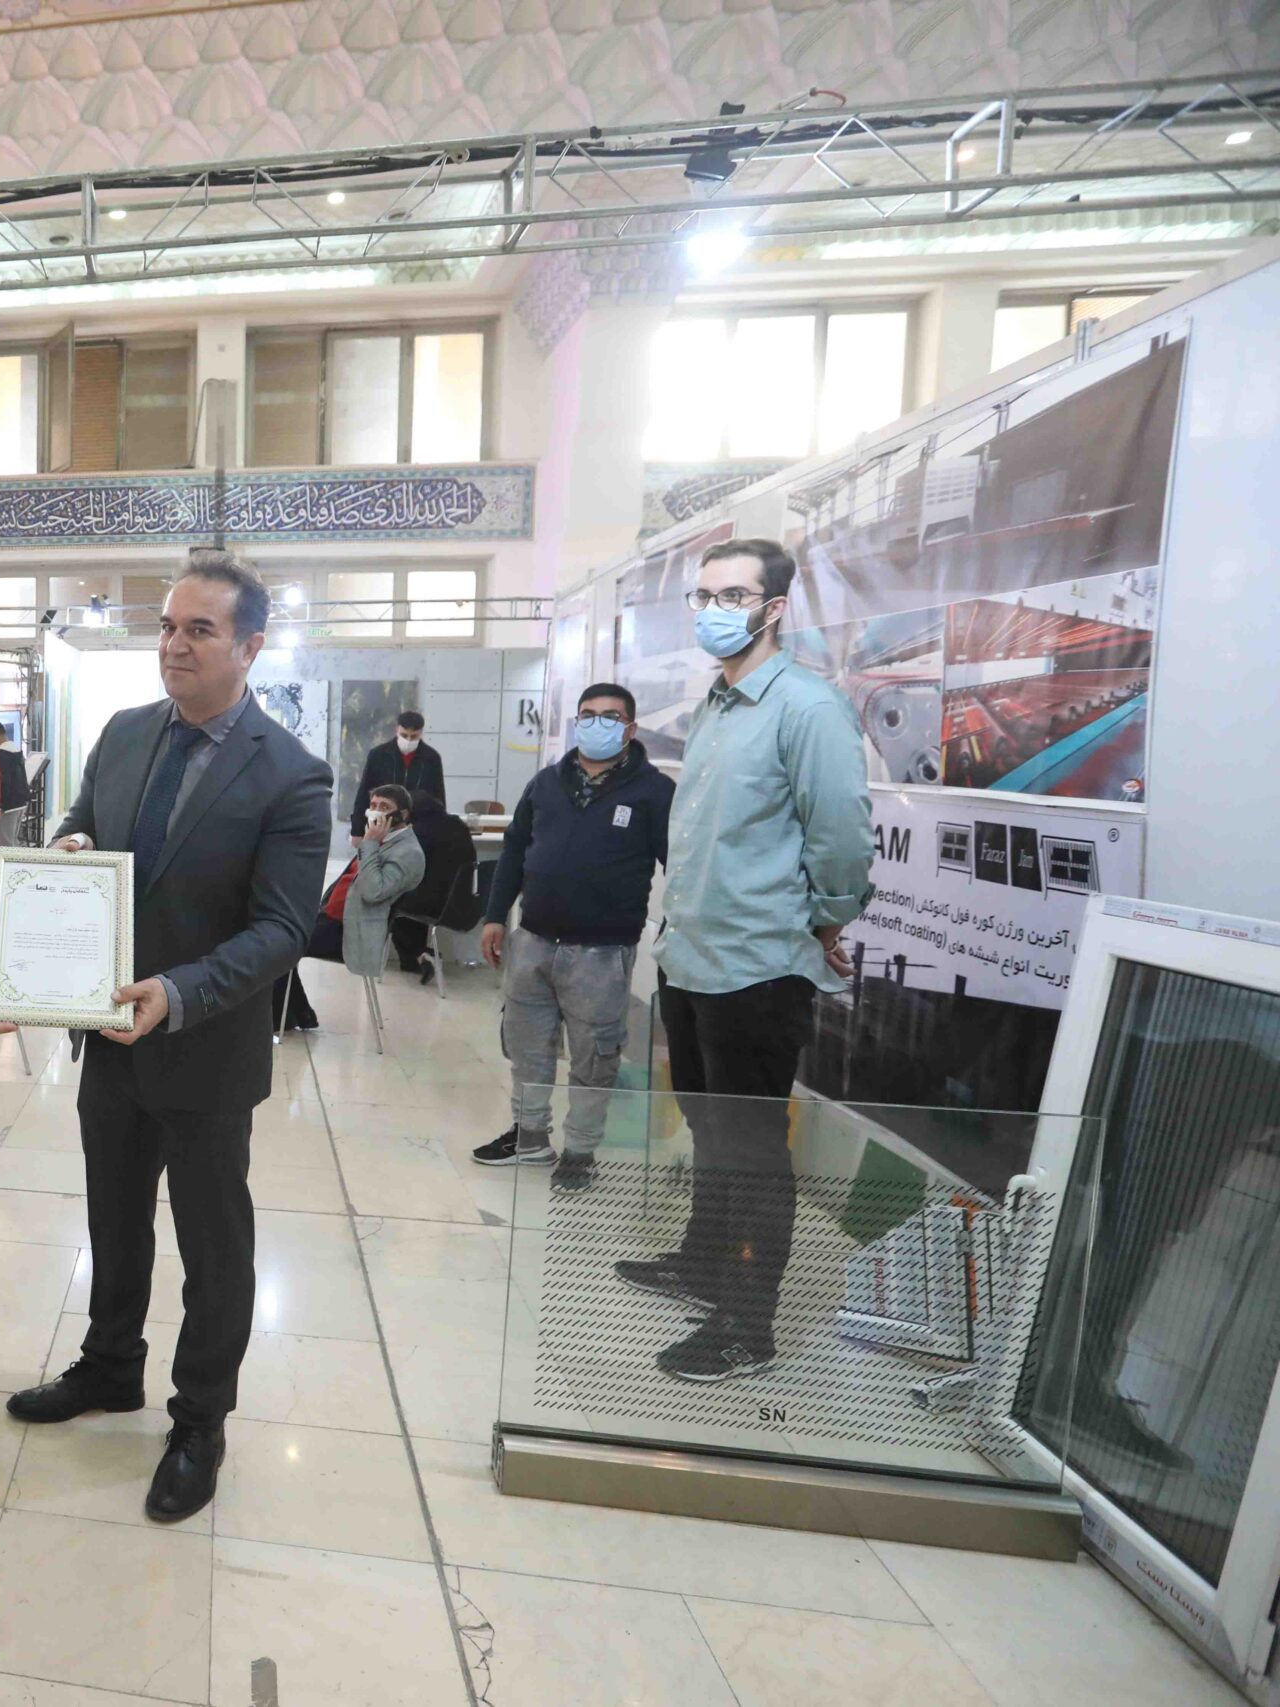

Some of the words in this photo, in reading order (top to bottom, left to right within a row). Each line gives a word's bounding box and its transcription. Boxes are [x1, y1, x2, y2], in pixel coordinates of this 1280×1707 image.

[980, 842, 1006, 864] Faraz
[951, 906, 970, 924] فول
[972, 915, 994, 931] کوره
[997, 920, 1024, 941] ورژن
[1027, 929, 1069, 949] آخرین
[948, 941, 965, 956] های
[968, 947, 999, 967] شیشه
[1000, 954, 1030, 977] انواع
